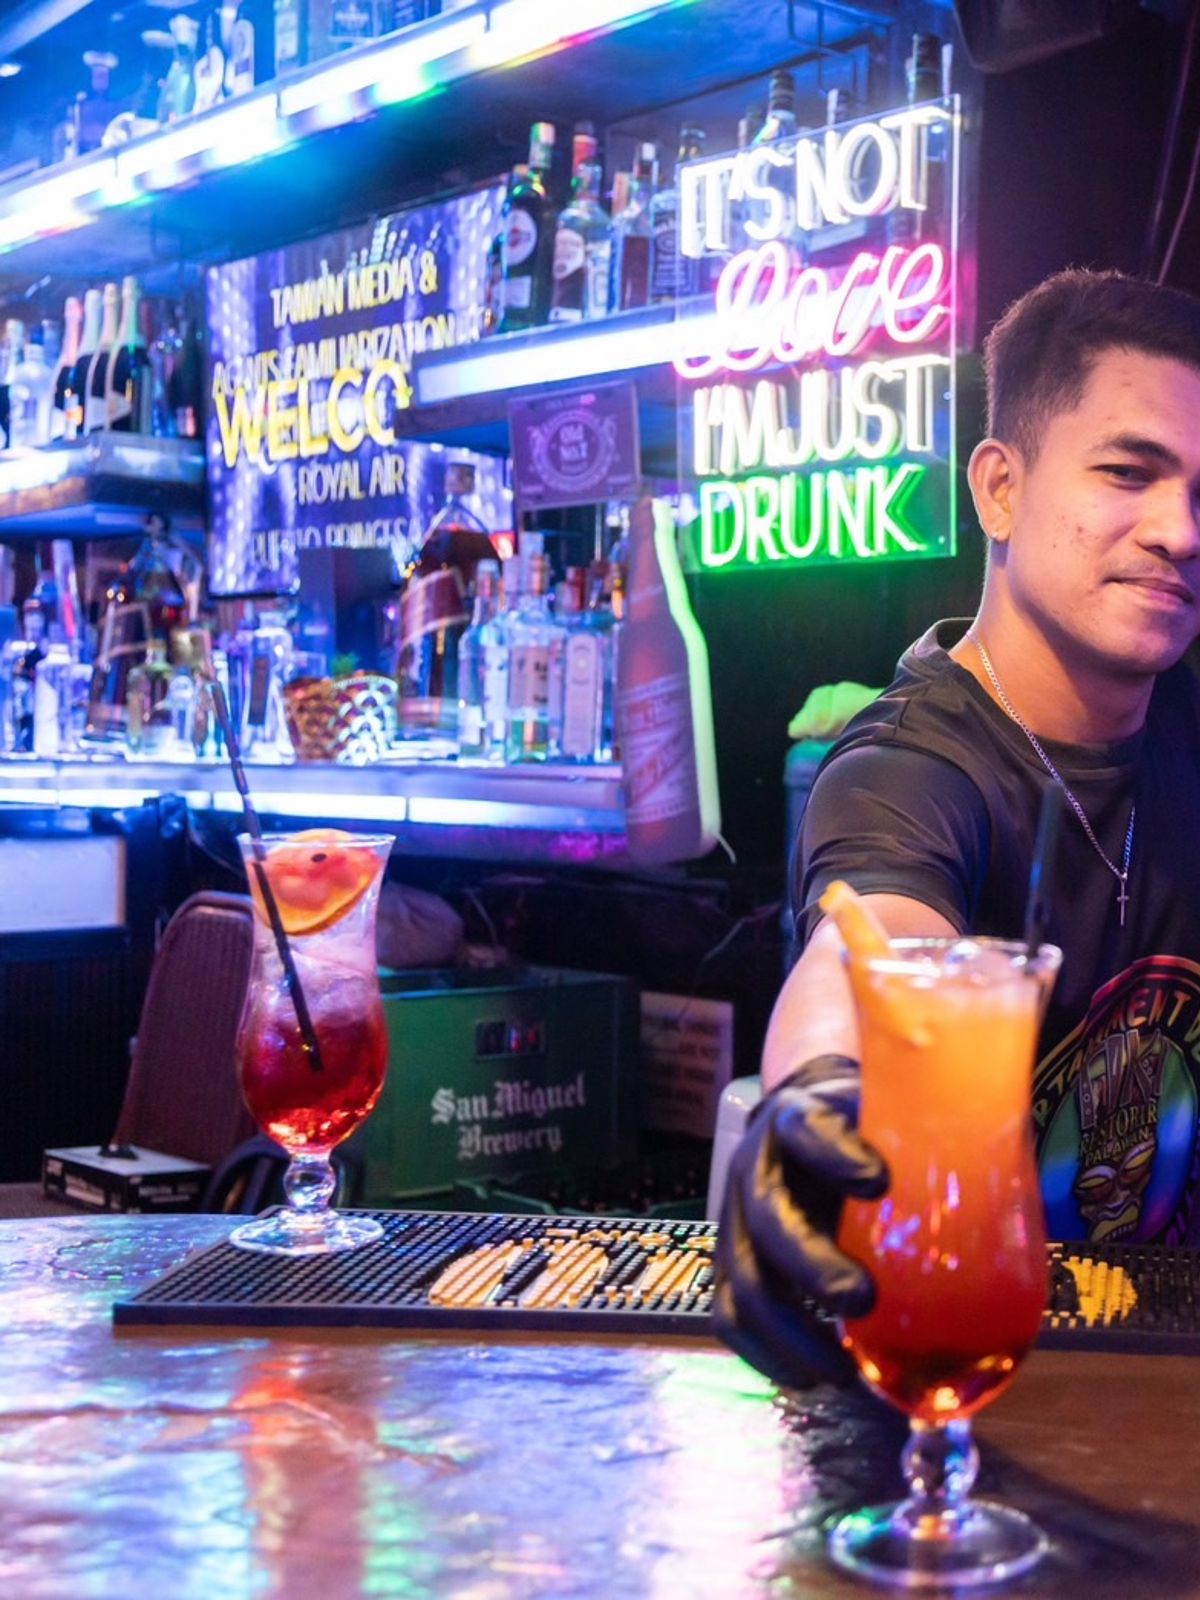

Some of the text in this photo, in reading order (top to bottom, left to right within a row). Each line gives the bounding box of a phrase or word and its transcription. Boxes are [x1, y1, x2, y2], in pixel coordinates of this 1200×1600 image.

[679, 146, 794, 259] IT'S
[796, 105, 953, 230] NOT
[348, 256, 415, 310] MEDIA
[420, 250, 438, 295] &
[214, 358, 411, 468] WELCO
[693, 353, 950, 475] I'M JUST
[299, 454, 406, 505] ROYAL AIR
[700, 463, 928, 567] DRUNK
[431, 1071, 586, 1125] San Miguel
[457, 1124, 563, 1160] Brewery
